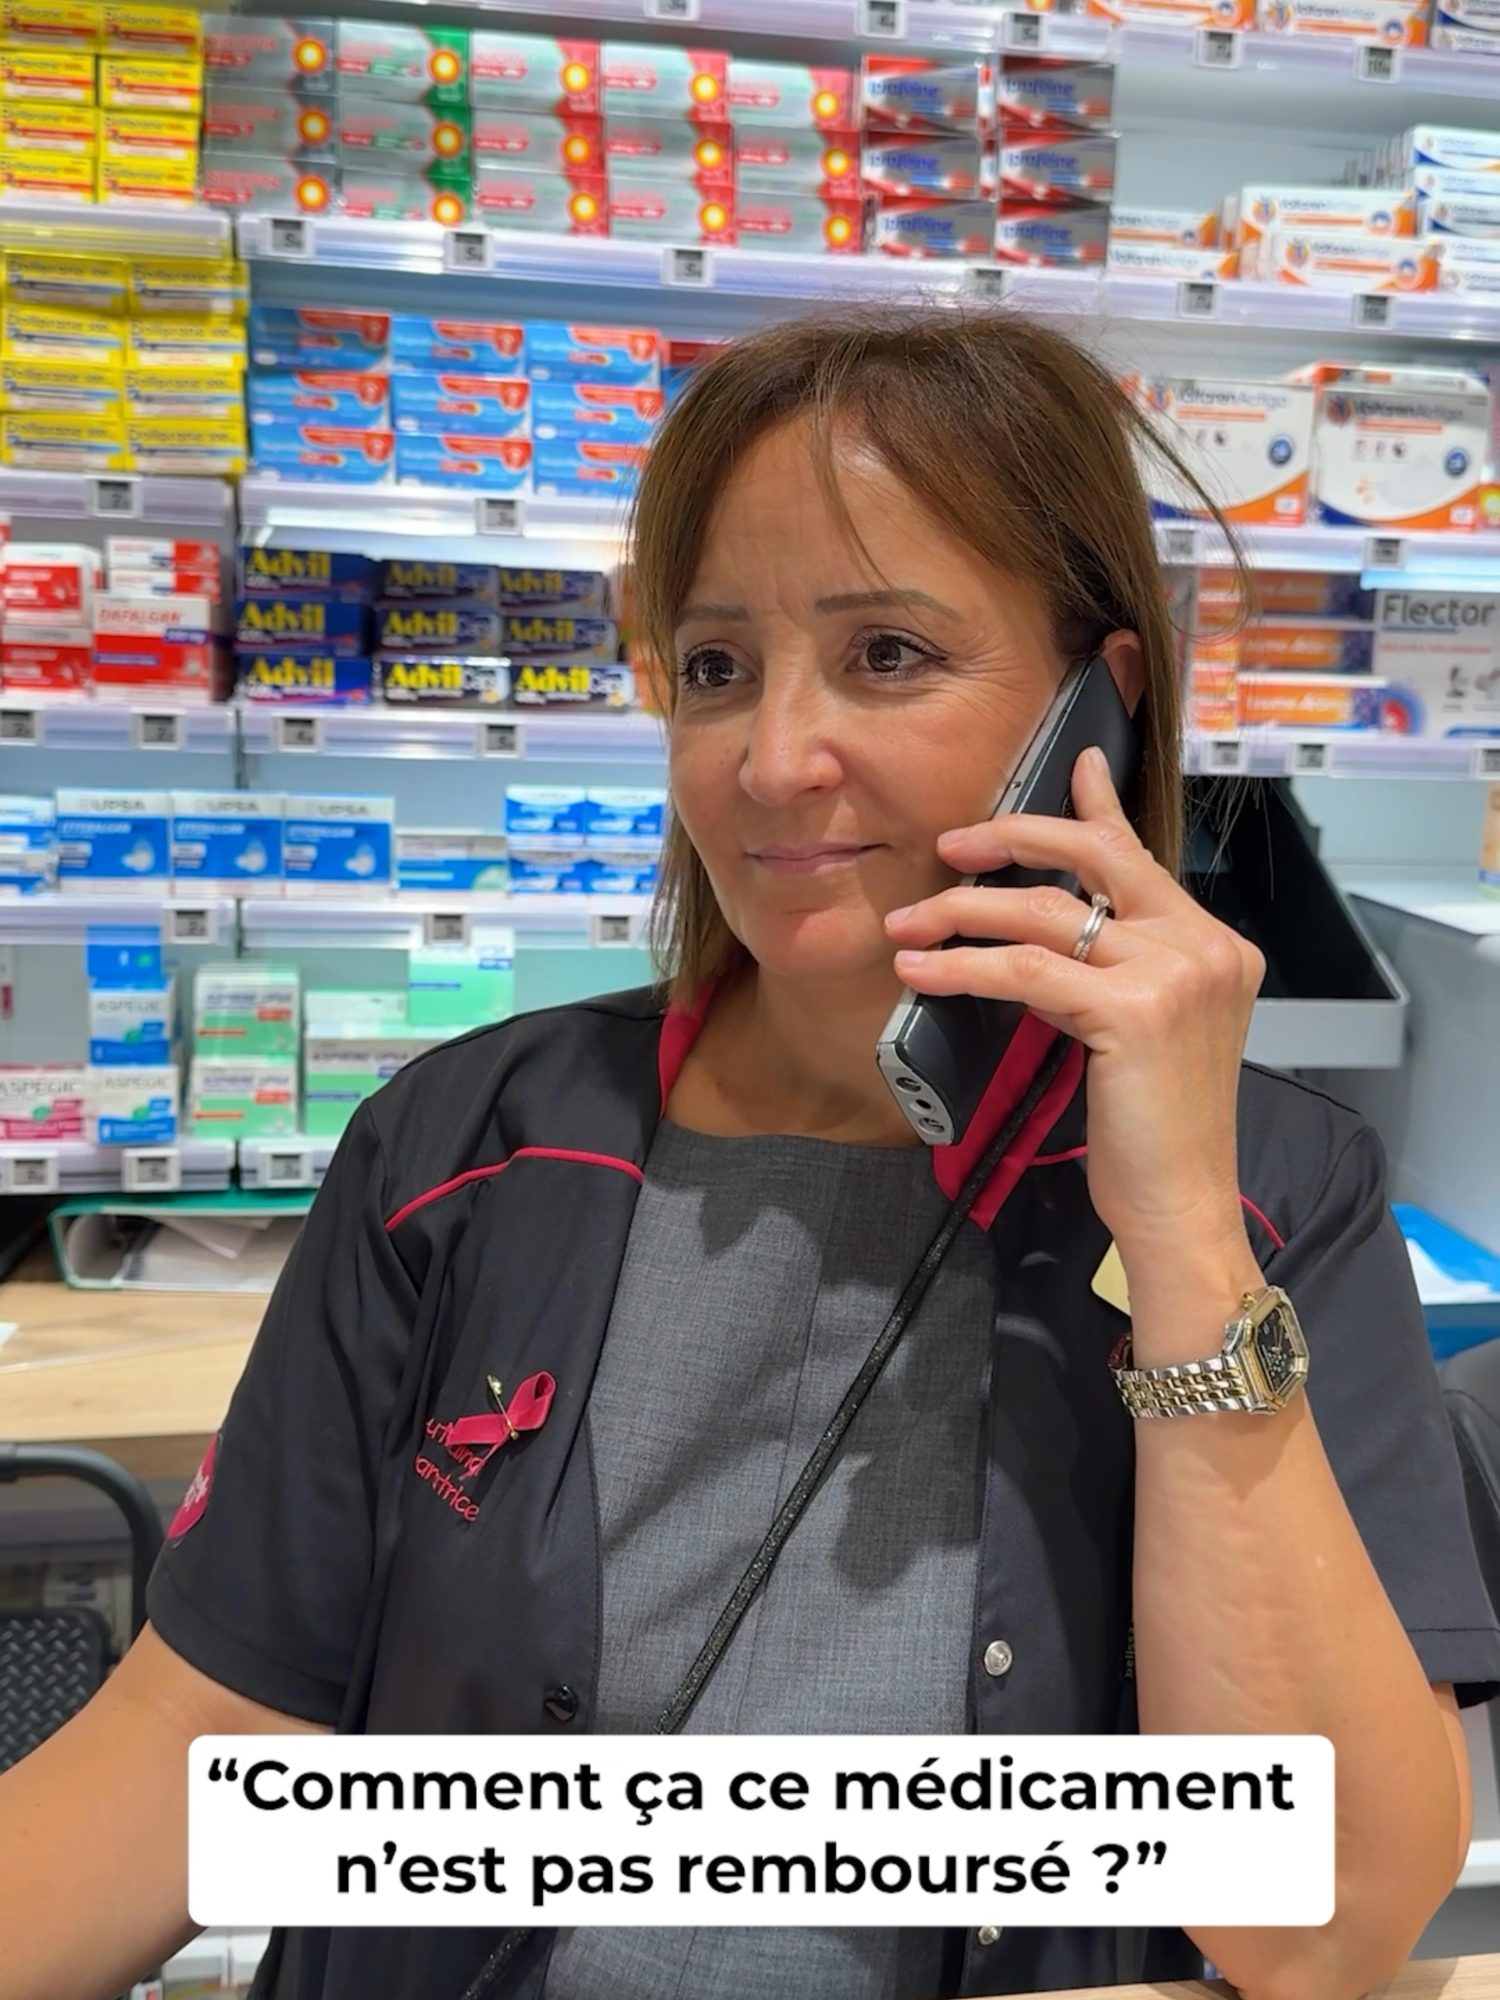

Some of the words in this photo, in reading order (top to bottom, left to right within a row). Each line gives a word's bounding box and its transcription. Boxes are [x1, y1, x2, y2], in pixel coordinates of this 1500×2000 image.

[247, 548, 331, 578] Advil
[385, 563, 456, 587] Advil
[500, 571, 562, 592] Advil
[239, 601, 325, 632] Advil
[383, 610, 457, 636] Advil
[1383, 594, 1497, 627] Flector
[508, 618, 574, 642] Advil
[247, 657, 334, 687] Advil
[386, 663, 463, 689] Advil
[516, 666, 590, 692] Advil
